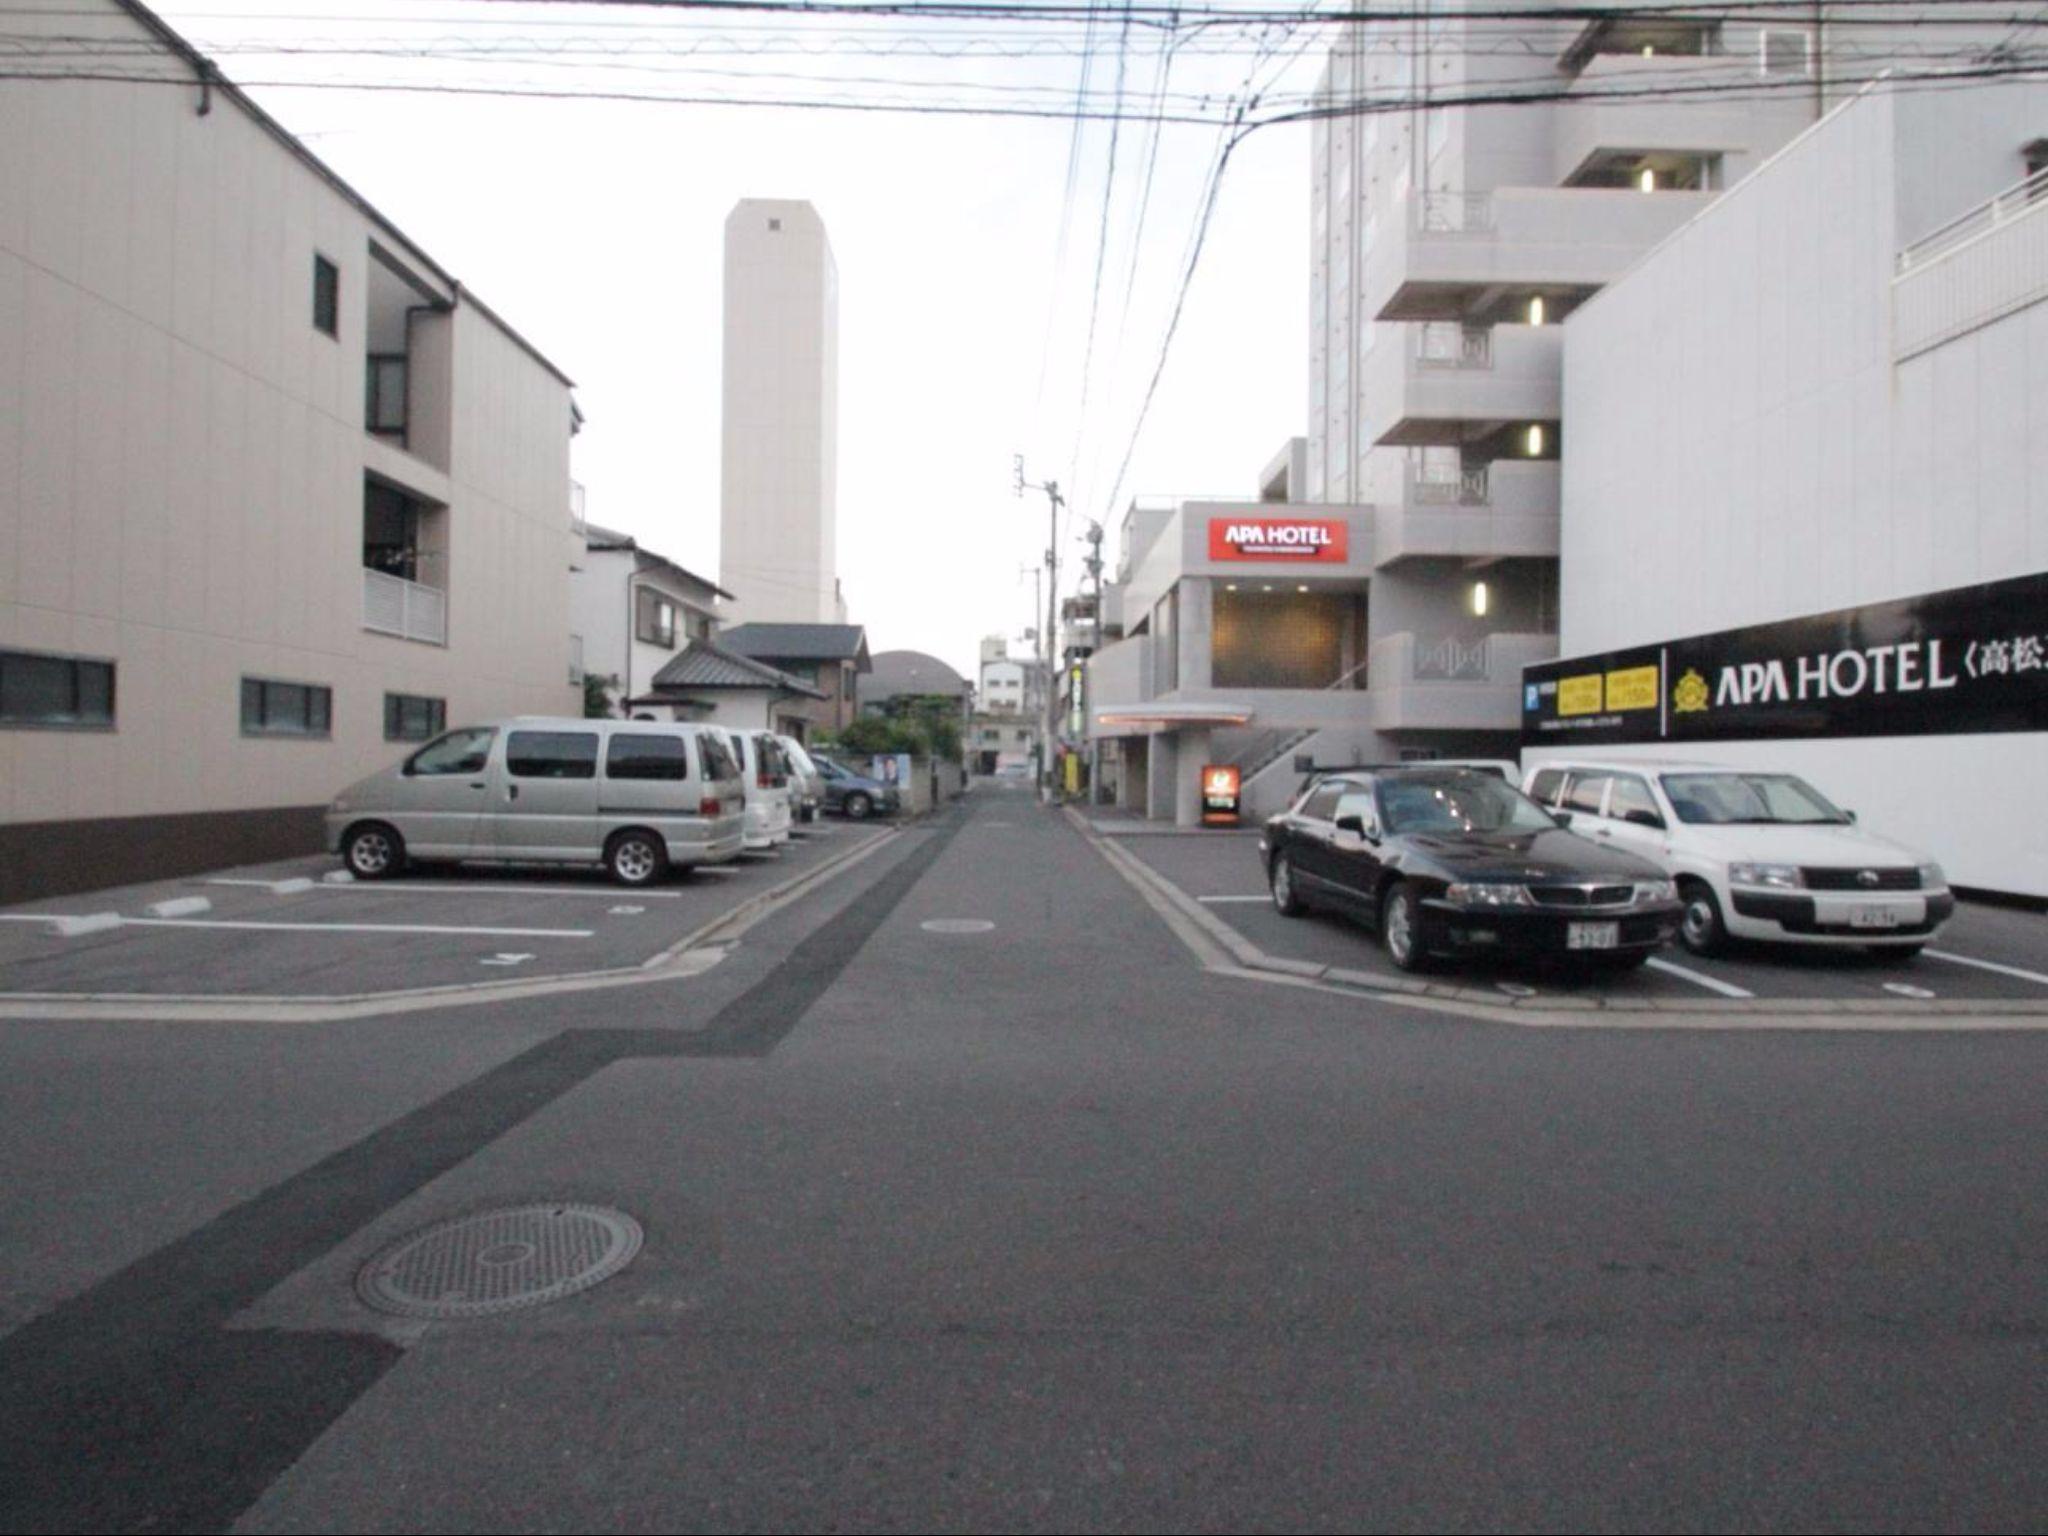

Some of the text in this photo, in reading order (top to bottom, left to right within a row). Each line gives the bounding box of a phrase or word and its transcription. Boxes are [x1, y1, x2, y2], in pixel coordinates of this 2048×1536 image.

[1225, 525, 1332, 544] APA HOTEL
[1716, 661, 1790, 706] APA
[1798, 639, 1958, 700] HOTEL
